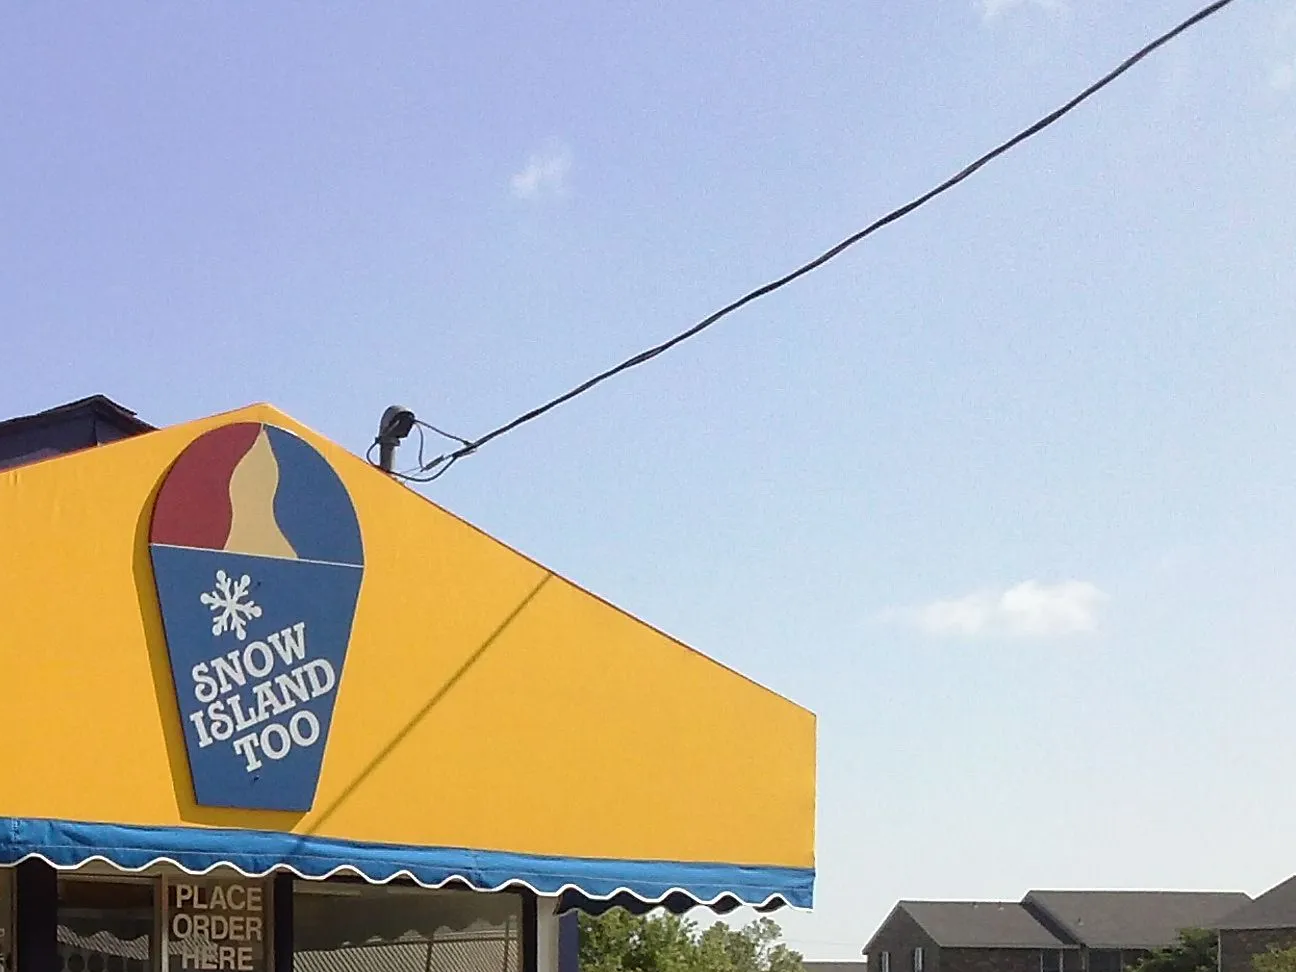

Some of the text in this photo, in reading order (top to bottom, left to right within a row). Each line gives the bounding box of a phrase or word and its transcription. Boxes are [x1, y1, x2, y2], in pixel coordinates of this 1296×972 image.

[192, 622, 306, 703] SNOW
[190, 658, 336, 748] ISLAND
[233, 710, 320, 772] TOO
[176, 883, 263, 911] PLACE
[172, 912, 263, 941] ORDER
[182, 944, 254, 971] HERE
